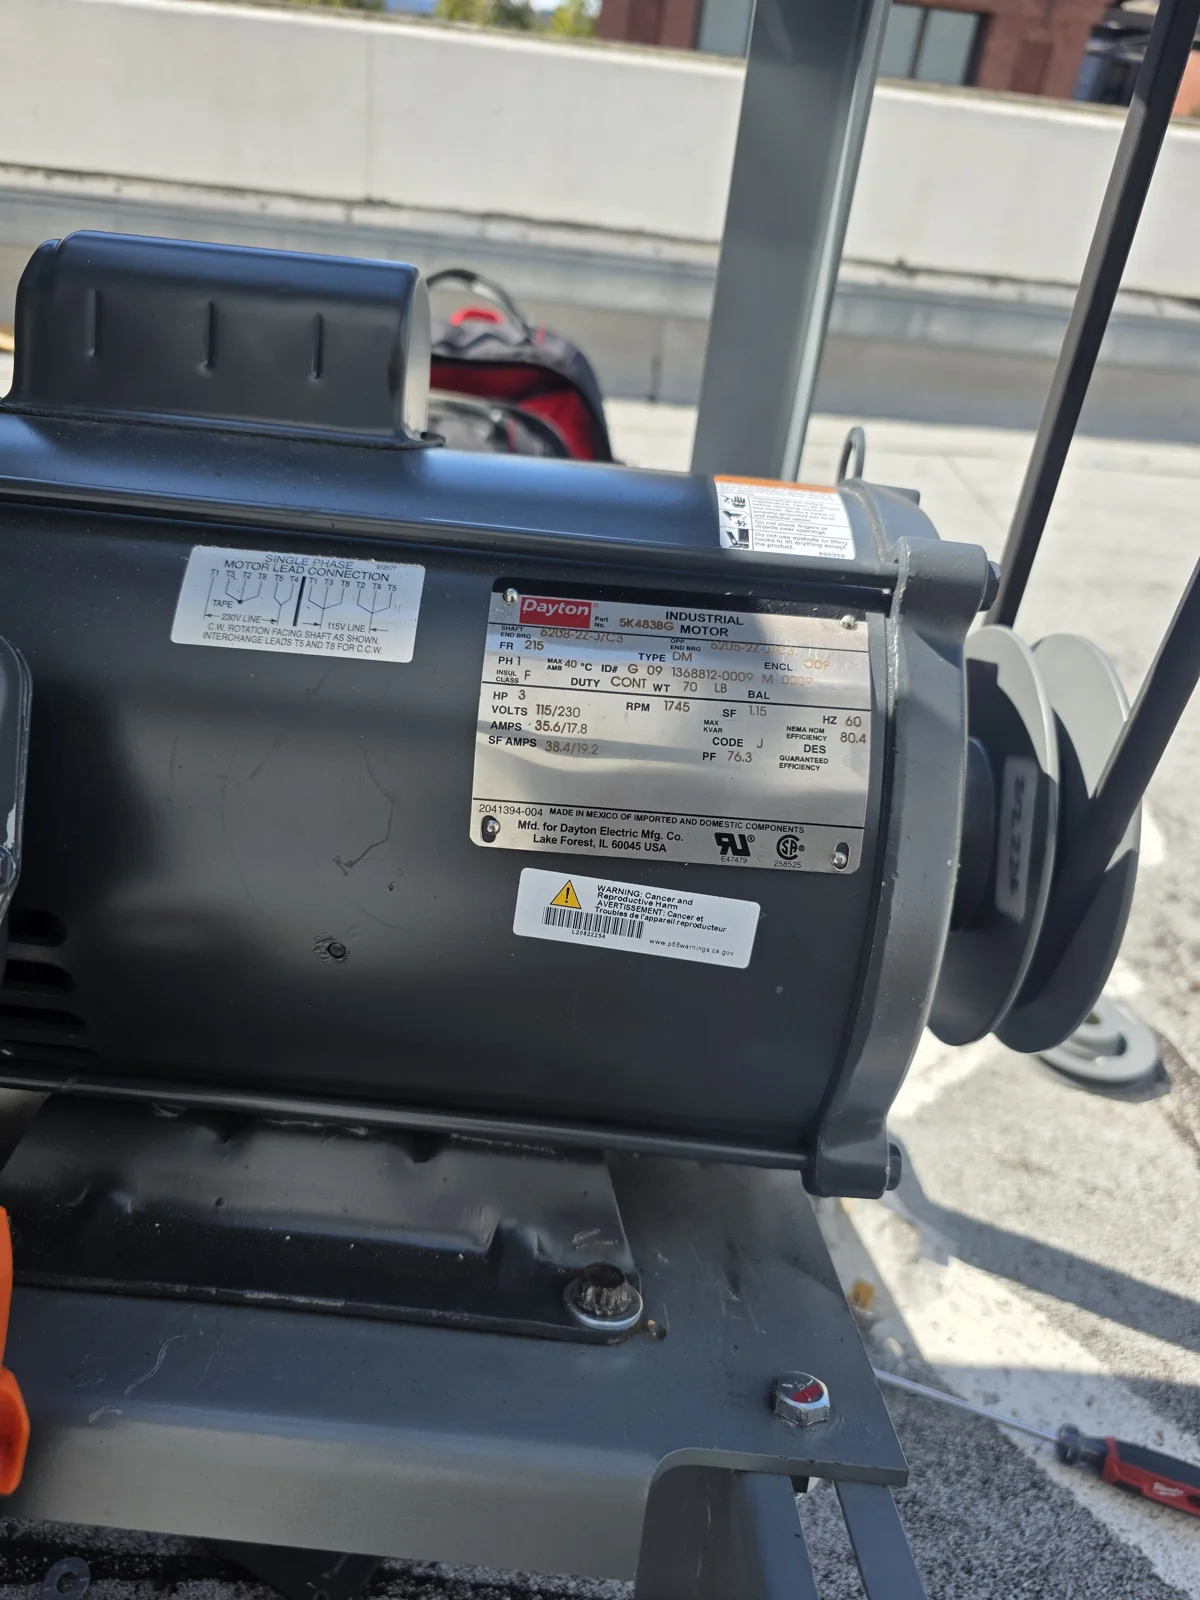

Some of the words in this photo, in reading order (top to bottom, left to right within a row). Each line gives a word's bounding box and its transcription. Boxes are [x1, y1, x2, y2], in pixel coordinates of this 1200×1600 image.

[265, 554, 309, 566] SINGLE
[313, 558, 354, 570] PHASE
[211, 568, 220, 576] T1
[226, 570, 236, 578] T3
[243, 571, 252, 579] T2
[258, 572, 268, 580] T8
[274, 574, 284, 582] T5
[290, 575, 299, 583] T4
[224, 560, 270, 571] MOTOR
[273, 564, 304, 574] LEAD
[308, 567, 390, 582] CONNECTION
[309, 577, 318, 585] T1
[324, 578, 334, 586] T3
[341, 580, 350, 588] T8
[356, 581, 366, 589] T2
[372, 582, 382, 590] T4
[388, 584, 397, 592] T5
[212, 599, 233, 609] TAPE
[522, 599, 589, 617] Dayton
[221, 613, 242, 622] 230V
[242, 615, 262, 624] LINE
[619, 618, 674, 631] 5K4838G
[665, 611, 744, 625] INDUSTRIAL
[207, 622, 226, 632] C.W.
[228, 624, 270, 635] ROTATION
[271, 627, 302, 638] FACING
[304, 630, 332, 640] SHAFT
[333, 633, 344, 641] AS
[346, 634, 380, 645] SHOWN.
[327, 622, 346, 631] 115V
[347, 624, 366, 633] LINE
[680, 624, 729, 637] MOTOR
[202, 631, 264, 644] INTERCHANGE
[265, 637, 292, 647] LEADS
[294, 638, 304, 647] T5
[305, 640, 323, 649] AND
[326, 641, 335, 650] T8
[337, 643, 355, 652] FOR
[356, 644, 383, 654] C.C.W.
[500, 641, 514, 650] FR
[524, 640, 544, 650] 215
[498, 656, 513, 665] PH
[517, 656, 521, 666] 1
[638, 652, 666, 662] TYPE
[672, 651, 692, 662] DM
[564, 659, 577, 669] 40
[764, 661, 793, 671] ENCL
[495, 676, 519, 684] CLASS
[524, 670, 531, 680] F
[601, 664, 618, 673] ID#
[628, 663, 639, 674] G
[647, 665, 663, 675] 09
[671, 666, 754, 682] 1368812-0009
[762, 673, 773, 684] M
[570, 677, 601, 687] DUTY
[610, 676, 647, 689] CONT
[653, 683, 671, 692] WT
[683, 681, 698, 692] 70
[714, 683, 728, 694] LB
[492, 691, 508, 700] HP
[518, 689, 526, 700] 3
[748, 690, 770, 700] BAL
[491, 704, 528, 716] VOLTS
[535, 703, 581, 718] 115/230
[625, 702, 650, 712] RPM
[663, 700, 690, 712] 1745
[722, 708, 737, 718] SF
[748, 705, 768, 717] 1.15
[490, 722, 522, 731] AMPS
[534, 719, 588, 735] 35.6/17.8
[822, 715, 838, 725] HZ
[845, 715, 862, 727] 60
[703, 726, 723, 734] KVAR
[786, 725, 807, 733] NEMA
[712, 736, 744, 748] CODE
[756, 738, 764, 749] J
[786, 733, 828, 742] EFFICIENCY
[839, 731, 867, 744] 80.4
[488, 735, 502, 745] SF
[505, 737, 537, 747] AMPS
[544, 740, 599, 755] 38.4/19.2
[803, 744, 827, 754] DES
[702, 752, 717, 761] PF
[727, 750, 752, 763] 76.3
[779, 755, 829, 765] GUARANTEED
[779, 762, 821, 772] EFFICIENCY
[478, 803, 544, 817] 2041394-004
[549, 808, 574, 817] MADE
[575, 809, 584, 817] IN
[586, 810, 618, 820] MEXICO
[620, 812, 632, 821] OF
[634, 813, 678, 824] IMPORTED
[679, 817, 698, 826] AND
[699, 819, 743, 829] DOMESTIC
[745, 822, 805, 834] COMPONENTS
[517, 819, 540, 831] Mfd.
[543, 821, 558, 832] for
[560, 823, 597, 836] Dayton
[599, 826, 638, 838] Electric
[641, 829, 663, 841] Mfg.
[666, 831, 684, 842] Co.
[533, 834, 558, 845] Lake
[560, 835, 596, 848] Forest,
[599, 839, 608, 848] IL
[611, 840, 641, 851] 60045
[644, 842, 667, 853] USA
[720, 855, 748, 864] E47479
[773, 860, 802, 869] 258525
[597, 884, 643, 898] WARNING:
[645, 892, 676, 903] Cancer
[597, 891, 653, 906] Reproductive
[656, 901, 678, 910] Harm
[597, 899, 666, 917] AVERTISSEMENT:
[667, 910, 694, 921] Cancer
[595, 905, 628, 918] Troubles
[676, 920, 727, 933] reproducteur
[649, 939, 735, 956] www.p65warnings.ca.gov
